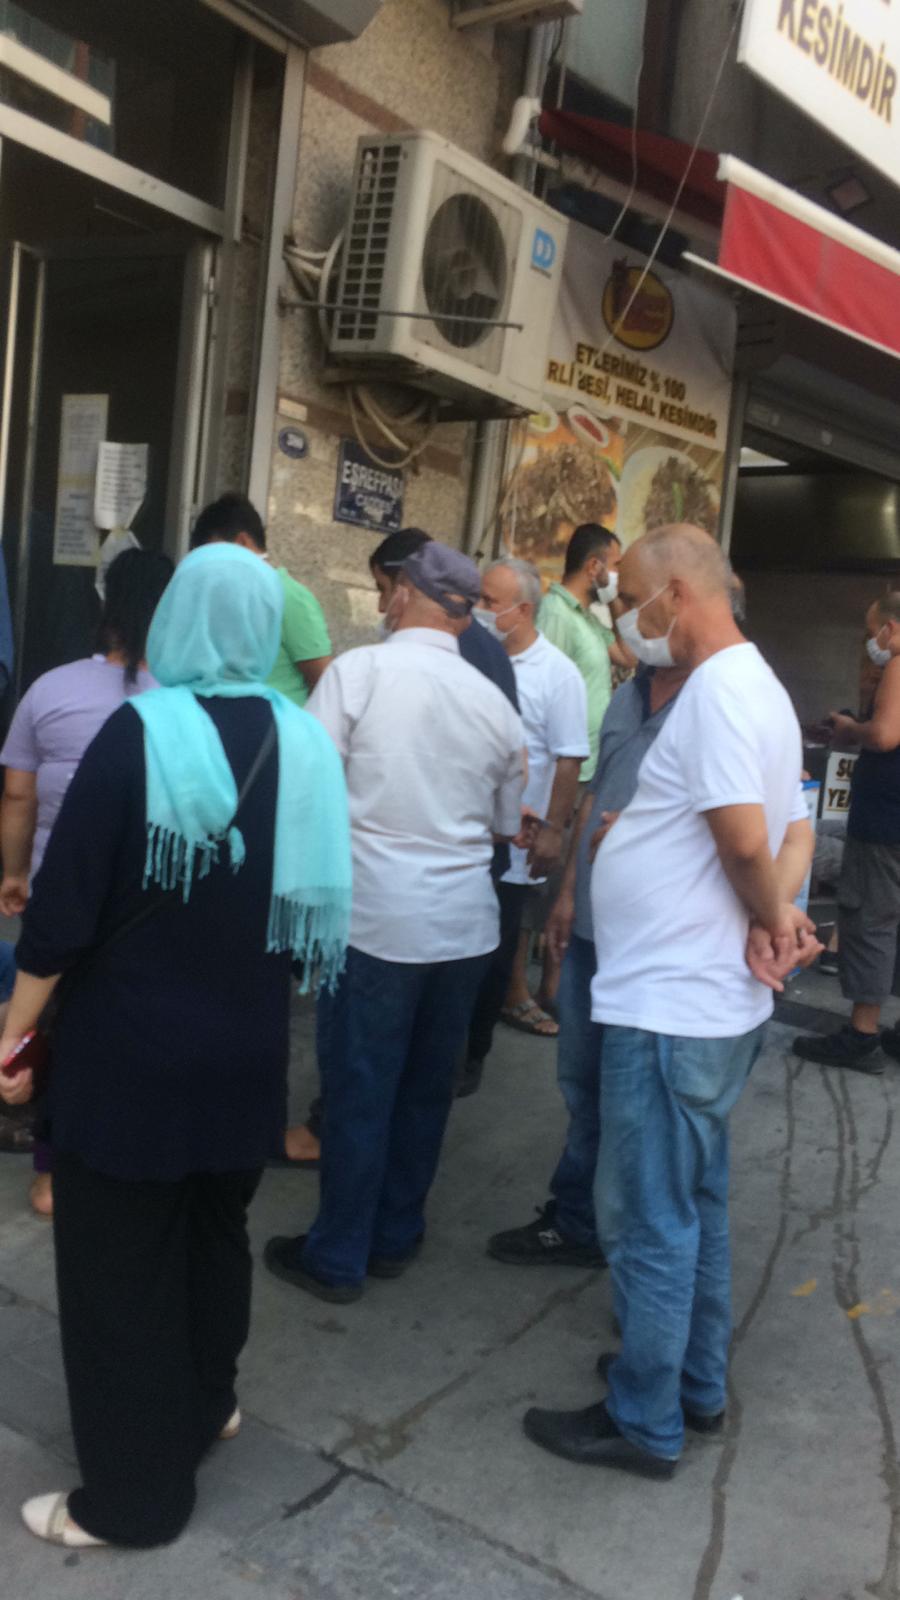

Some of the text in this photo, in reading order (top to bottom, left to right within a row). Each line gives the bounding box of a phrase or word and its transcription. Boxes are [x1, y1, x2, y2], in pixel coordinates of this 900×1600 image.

[777, 0, 897, 123] KESİMDİR
[615, 384, 656, 416] HELAL
[658, 401, 718, 439] KESİMDİR
[828, 787, 851, 808] YE
